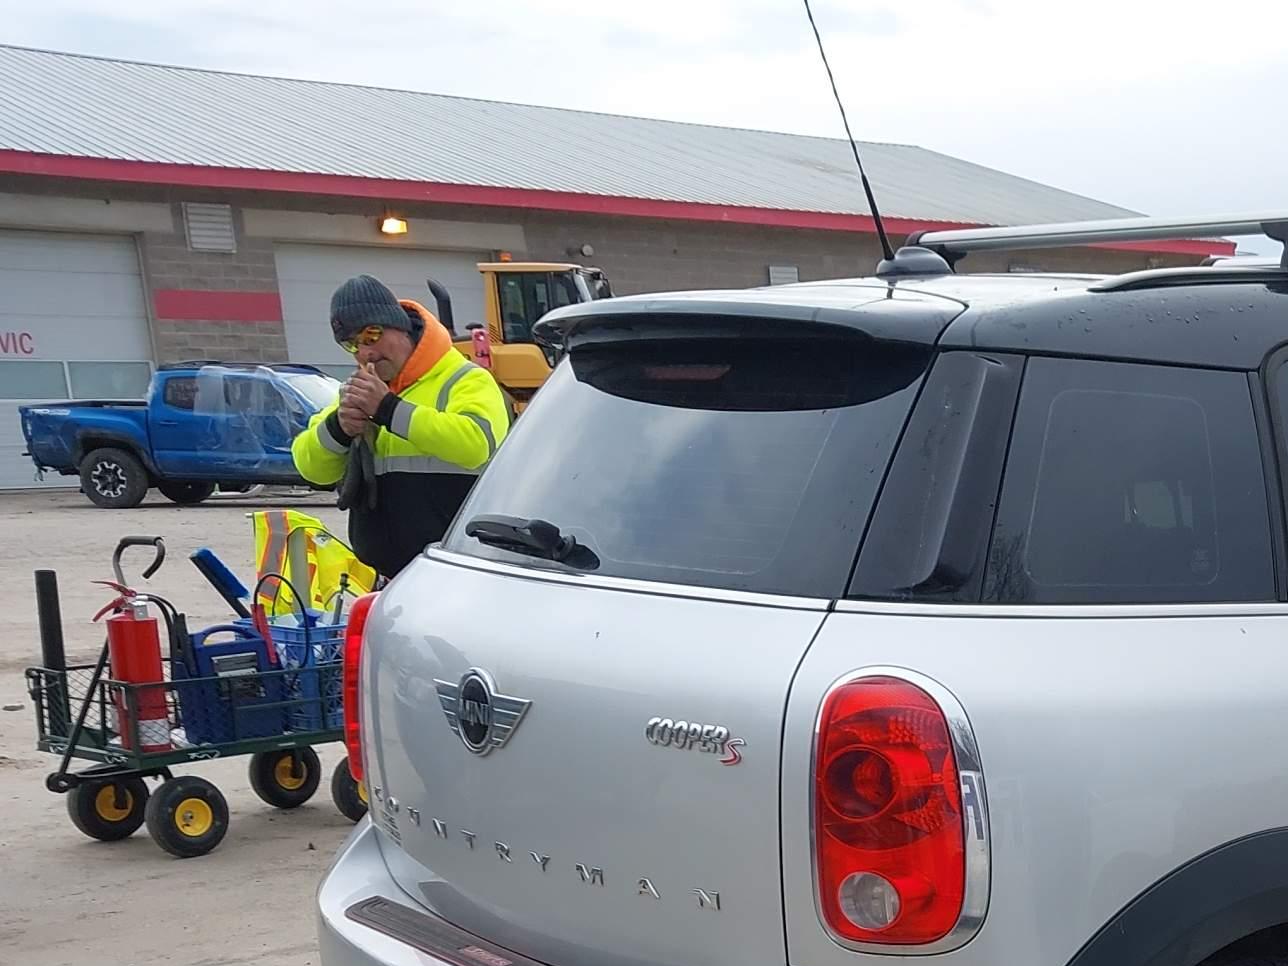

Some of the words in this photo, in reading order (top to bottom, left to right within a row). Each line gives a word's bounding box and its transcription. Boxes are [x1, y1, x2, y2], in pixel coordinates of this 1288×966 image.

[463, 699, 489, 726] MINI
[646, 717, 729, 755] COOPER
[719, 738, 746, 767] S
[374, 785, 721, 911] COUNTRYMAN
